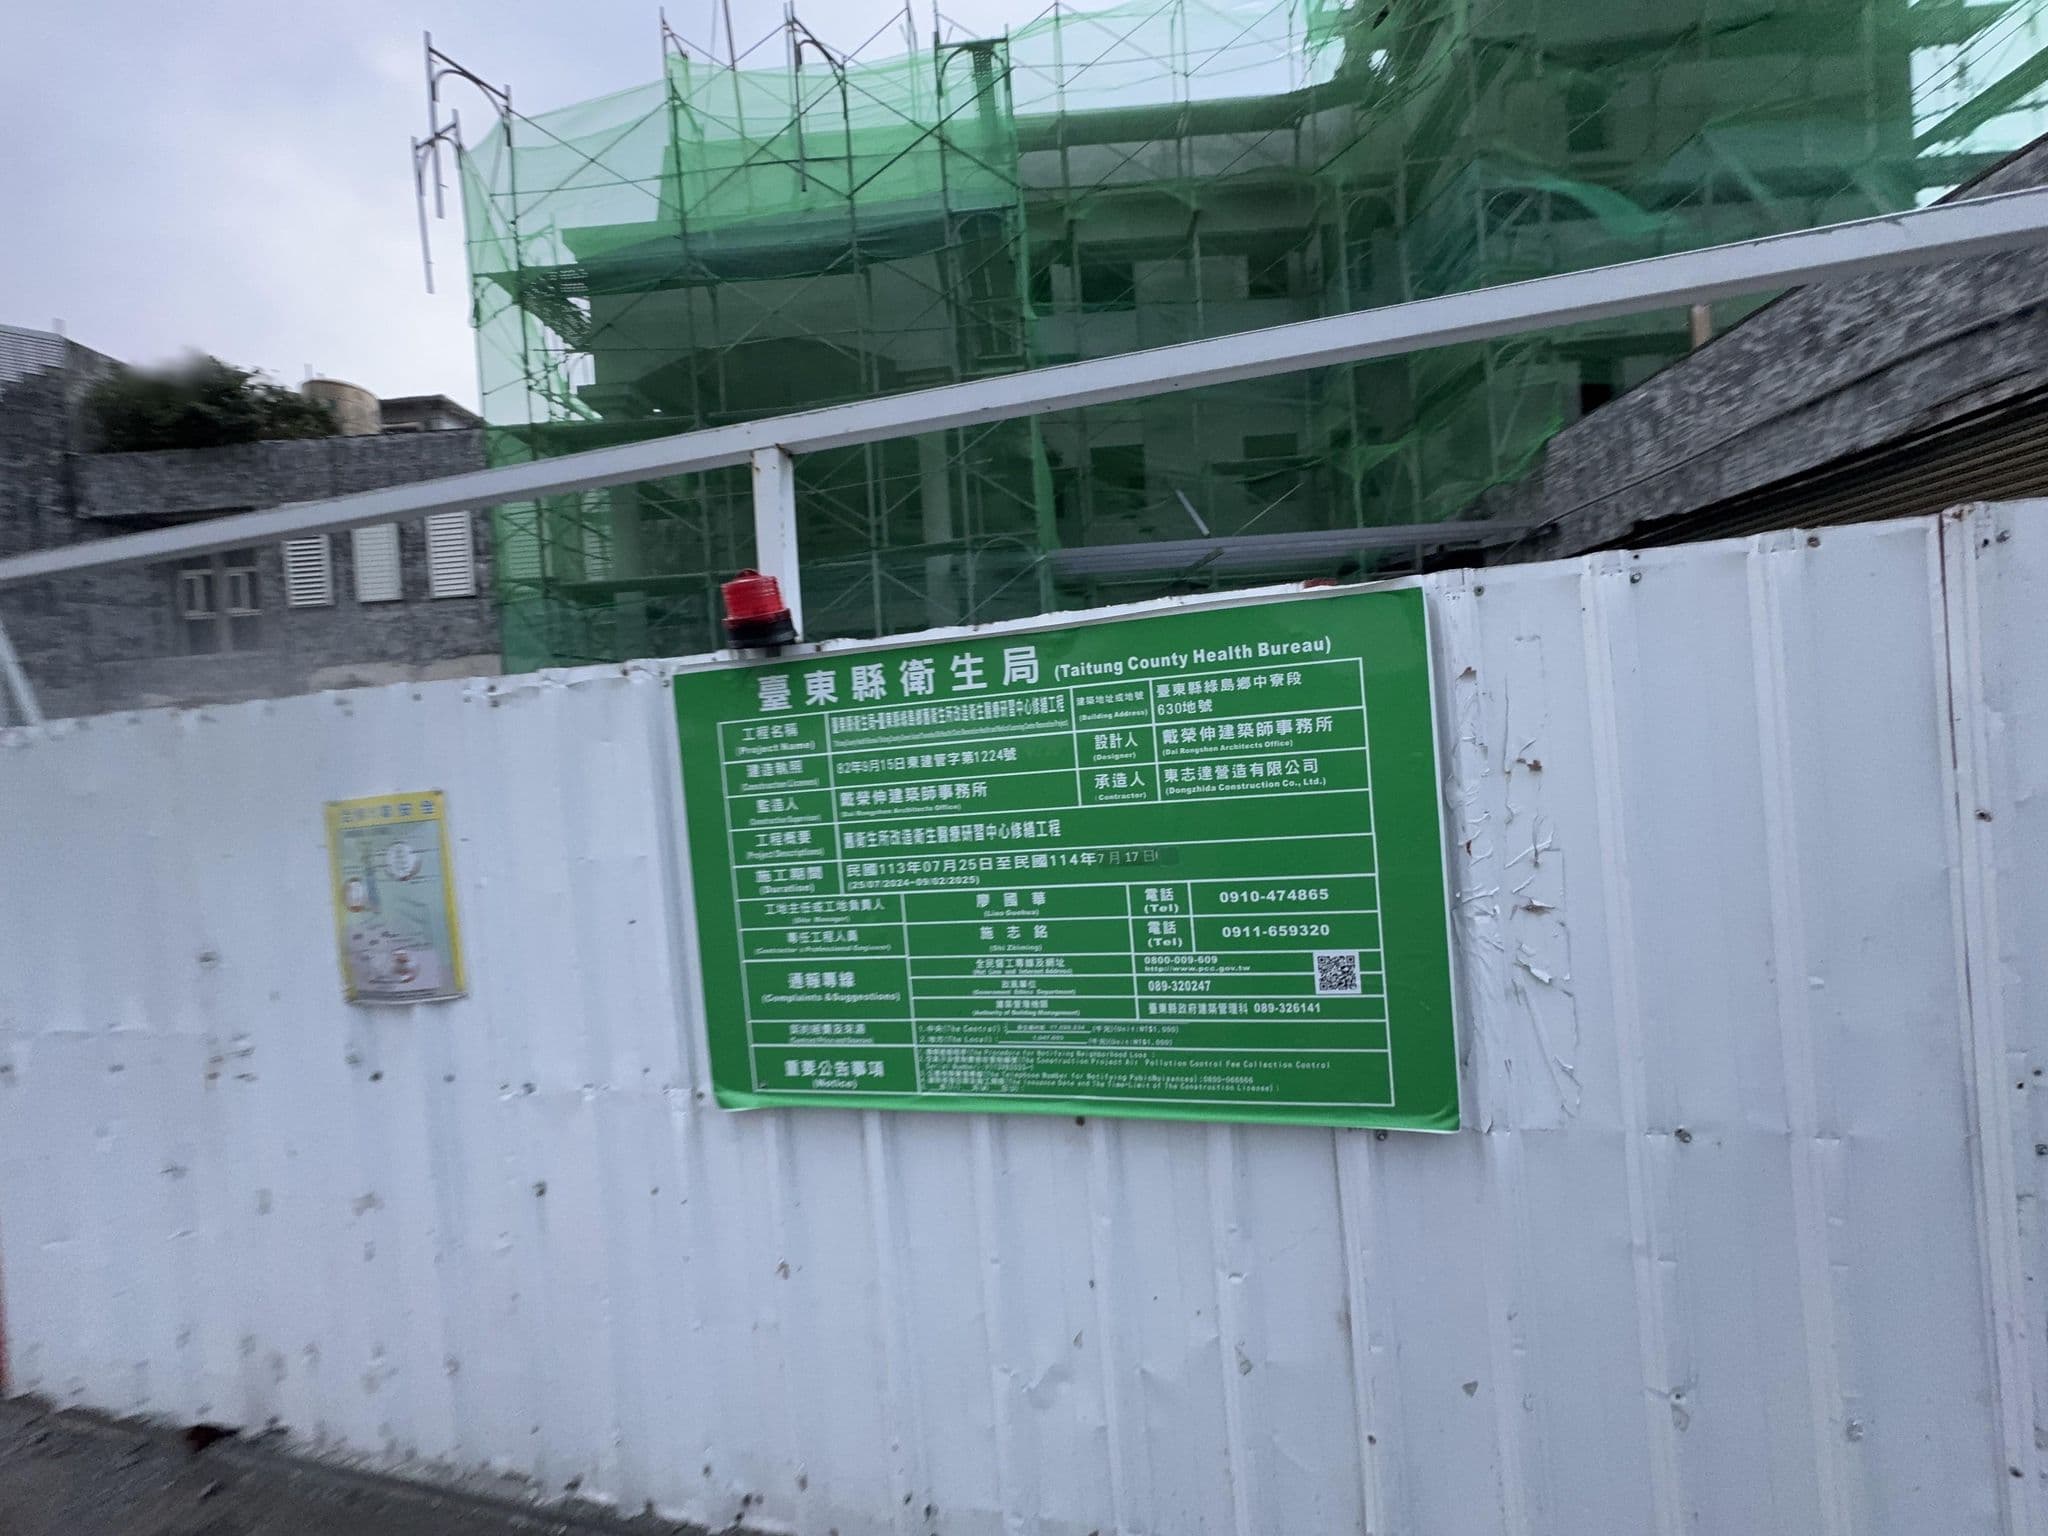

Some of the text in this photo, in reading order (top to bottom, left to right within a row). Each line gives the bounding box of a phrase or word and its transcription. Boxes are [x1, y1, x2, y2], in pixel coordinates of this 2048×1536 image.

[1054, 635, 1332, 681] (Taitung County Health Bureau)
[757, 645, 1039, 711] 臺東縣衛生局
[1156, 671, 1302, 697] 臺東縣綠島鄉中寮段
[1076, 691, 1144, 706] 建築地址或地號
[1157, 699, 1213, 716] 630地號
[741, 722, 798, 741] 工程名稱
[1162, 715, 1333, 745] 戴榮伸建築師事務所
[1094, 732, 1138, 750] 設計人
[1220, 741, 1262, 752] Architects
[1264, 738, 1294, 749] Office)
[1093, 751, 1136, 762] (Designer)
[1164, 758, 1319, 783] 東志達營造有限公司
[1094, 771, 1145, 789] 承造人
[1165, 784, 1217, 795] (Dongzhida
[1218, 779, 1281, 792] Construction
[1302, 776, 1326, 786] Ltd.)
[975, 891, 1047, 907] 廖國華
[1143, 887, 1174, 901] 電話
[1219, 888, 1329, 903] 0910-474865
[1143, 904, 1179, 914] (Tel)
[979, 924, 1049, 940] 施志銘
[1147, 920, 1177, 934] 電話
[1221, 924, 1330, 938] 0911-659320
[1147, 937, 1183, 947] (Tel)
[1144, 955, 1218, 965] 0800-009-609
[1148, 980, 1211, 991] 089-320247
[1254, 1002, 1321, 1014] 089-326141
